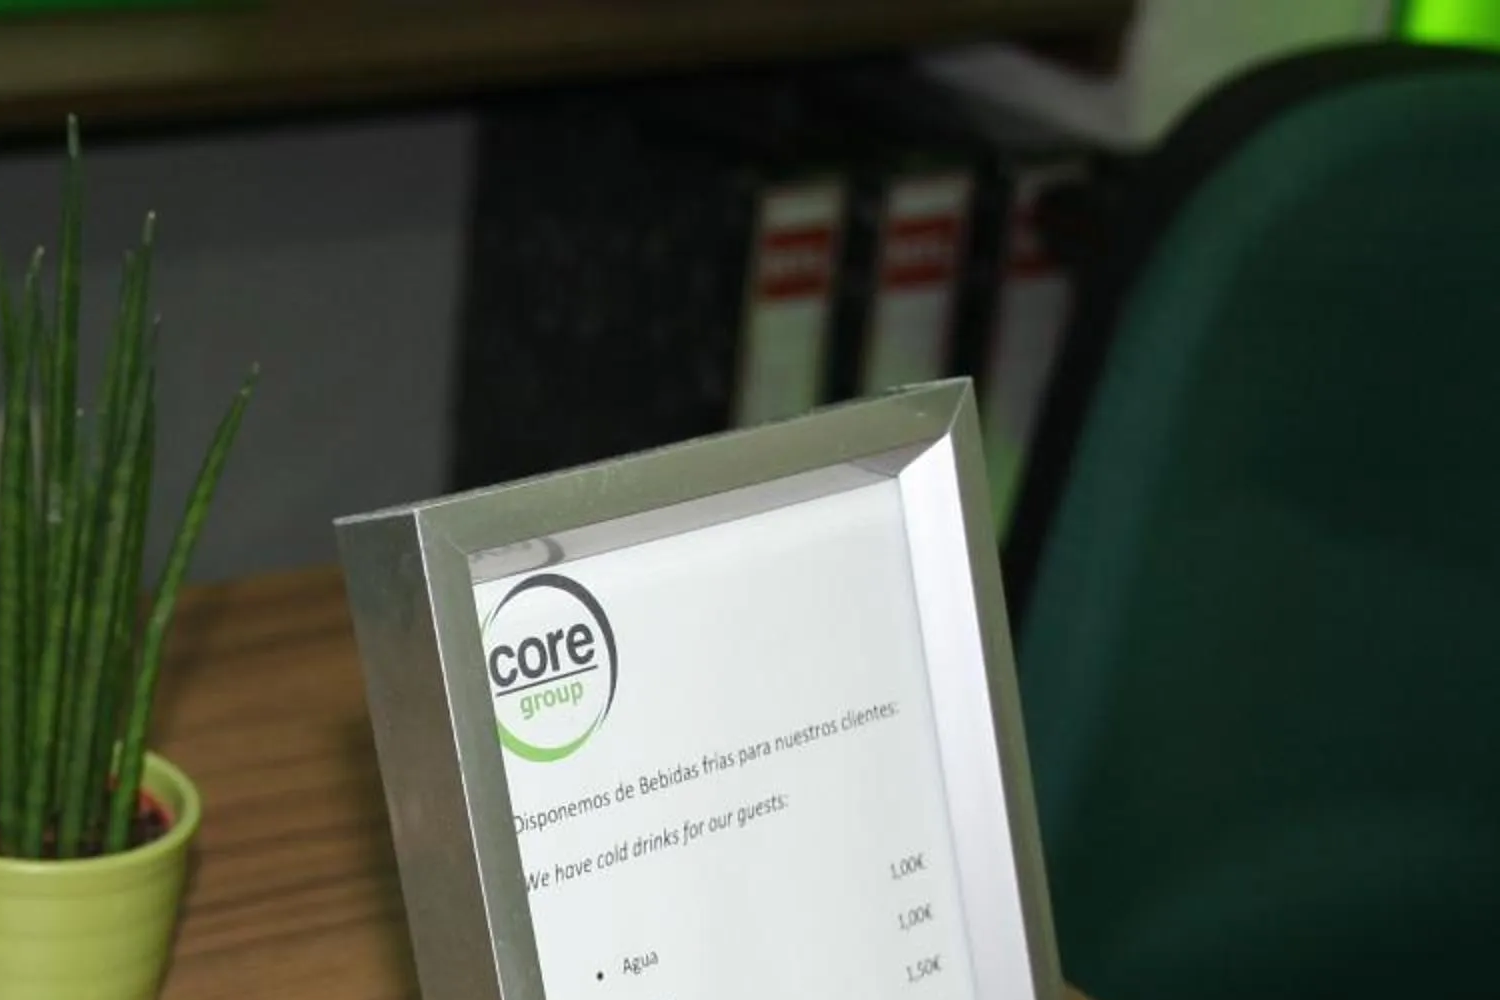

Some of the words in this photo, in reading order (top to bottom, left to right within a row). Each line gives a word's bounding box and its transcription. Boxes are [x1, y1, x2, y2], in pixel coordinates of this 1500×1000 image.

[489, 623, 595, 687] core
[520, 681, 584, 720] group
[513, 791, 611, 834] Disponemos
[615, 781, 635, 803] de
[639, 762, 699, 796] Bebidas
[738, 740, 771, 768] para
[775, 719, 839, 752] nuestros
[841, 701, 900, 732] clientes:
[525, 869, 550, 893] We
[555, 857, 592, 883] have
[597, 840, 629, 869] cold
[633, 827, 680, 858] drinks
[682, 819, 704, 846] for
[708, 811, 733, 833] our
[737, 793, 790, 828] guests:
[890, 852, 927, 880] 1,00€
[898, 902, 933, 932] 1,00€
[622, 950, 659, 976] Agua
[906, 954, 942, 983] 1,50€
